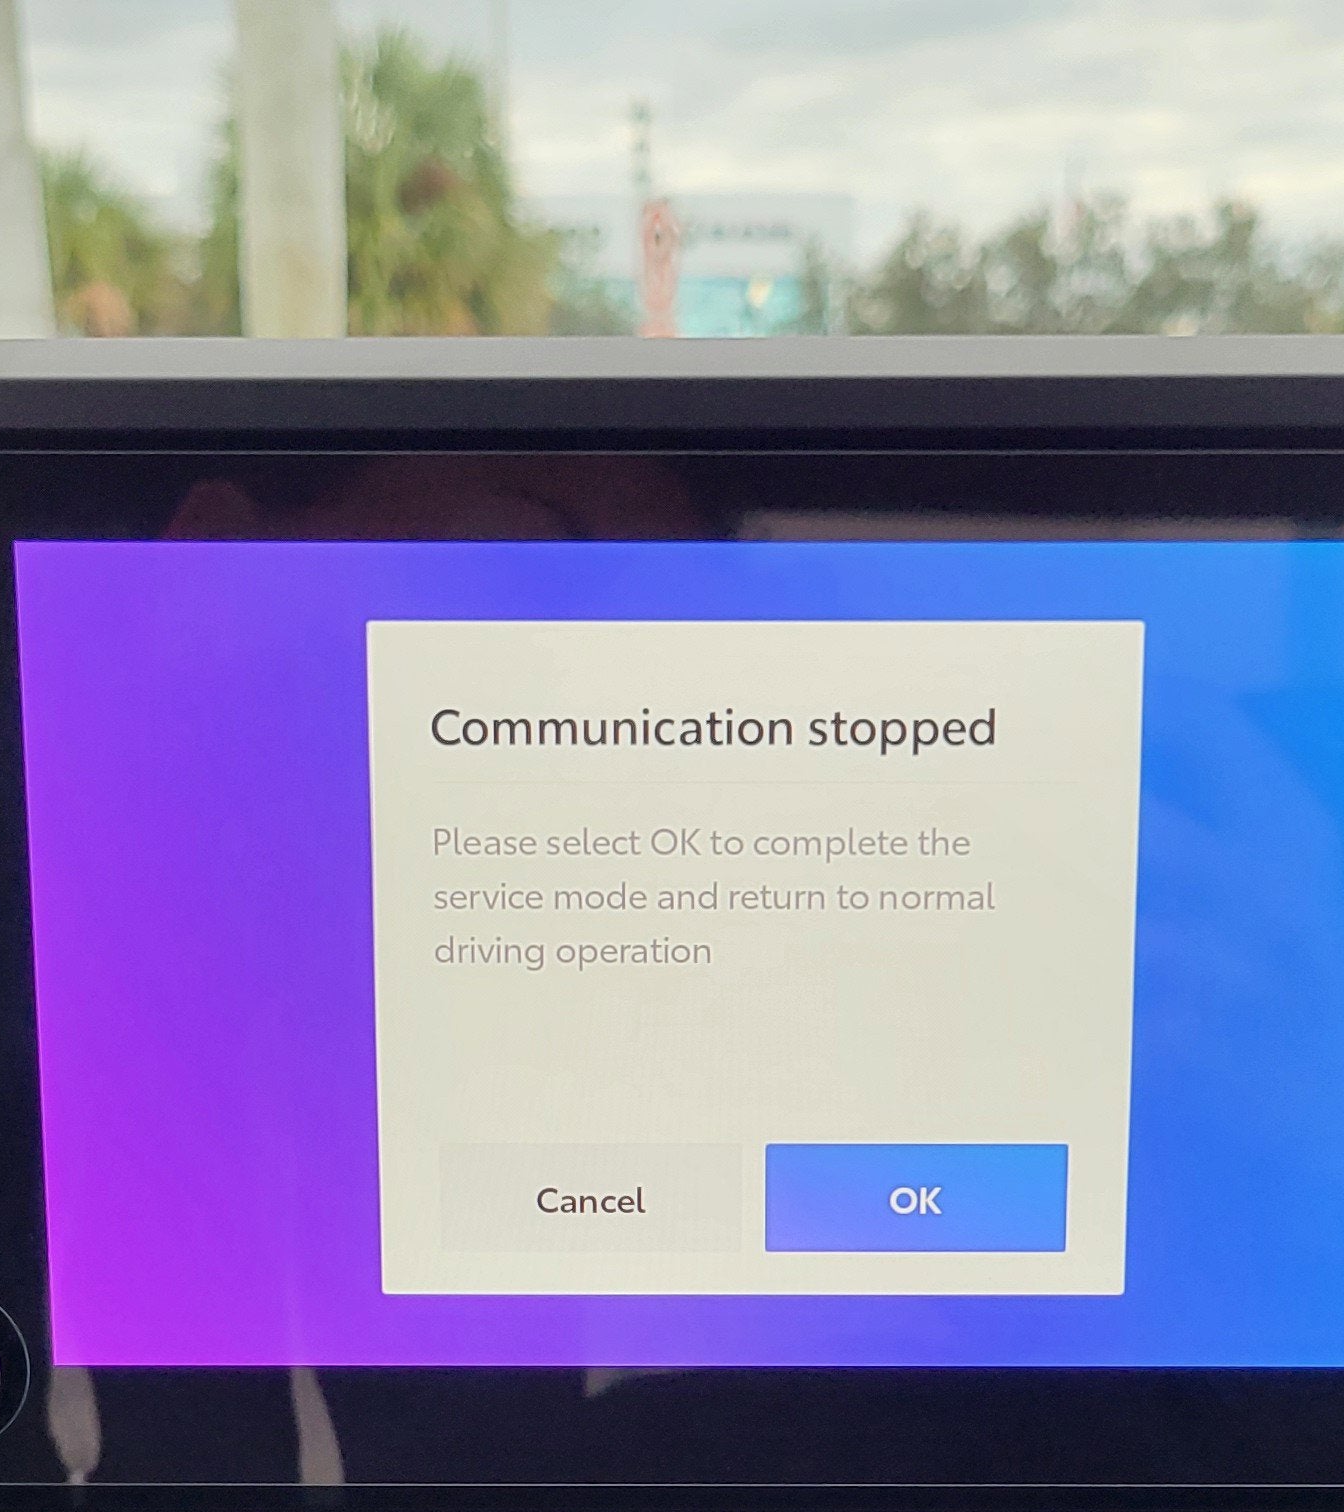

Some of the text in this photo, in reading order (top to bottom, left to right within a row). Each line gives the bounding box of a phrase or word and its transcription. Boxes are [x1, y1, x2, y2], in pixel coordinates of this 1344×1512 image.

[431, 707, 996, 756] Communication stopped
[433, 826, 971, 864] Please select OK to complete the
[434, 881, 995, 911] service mode and return to normal
[434, 935, 712, 972] driving operation
[536, 1186, 646, 1214] Cancel
[889, 1186, 942, 1215] OK
